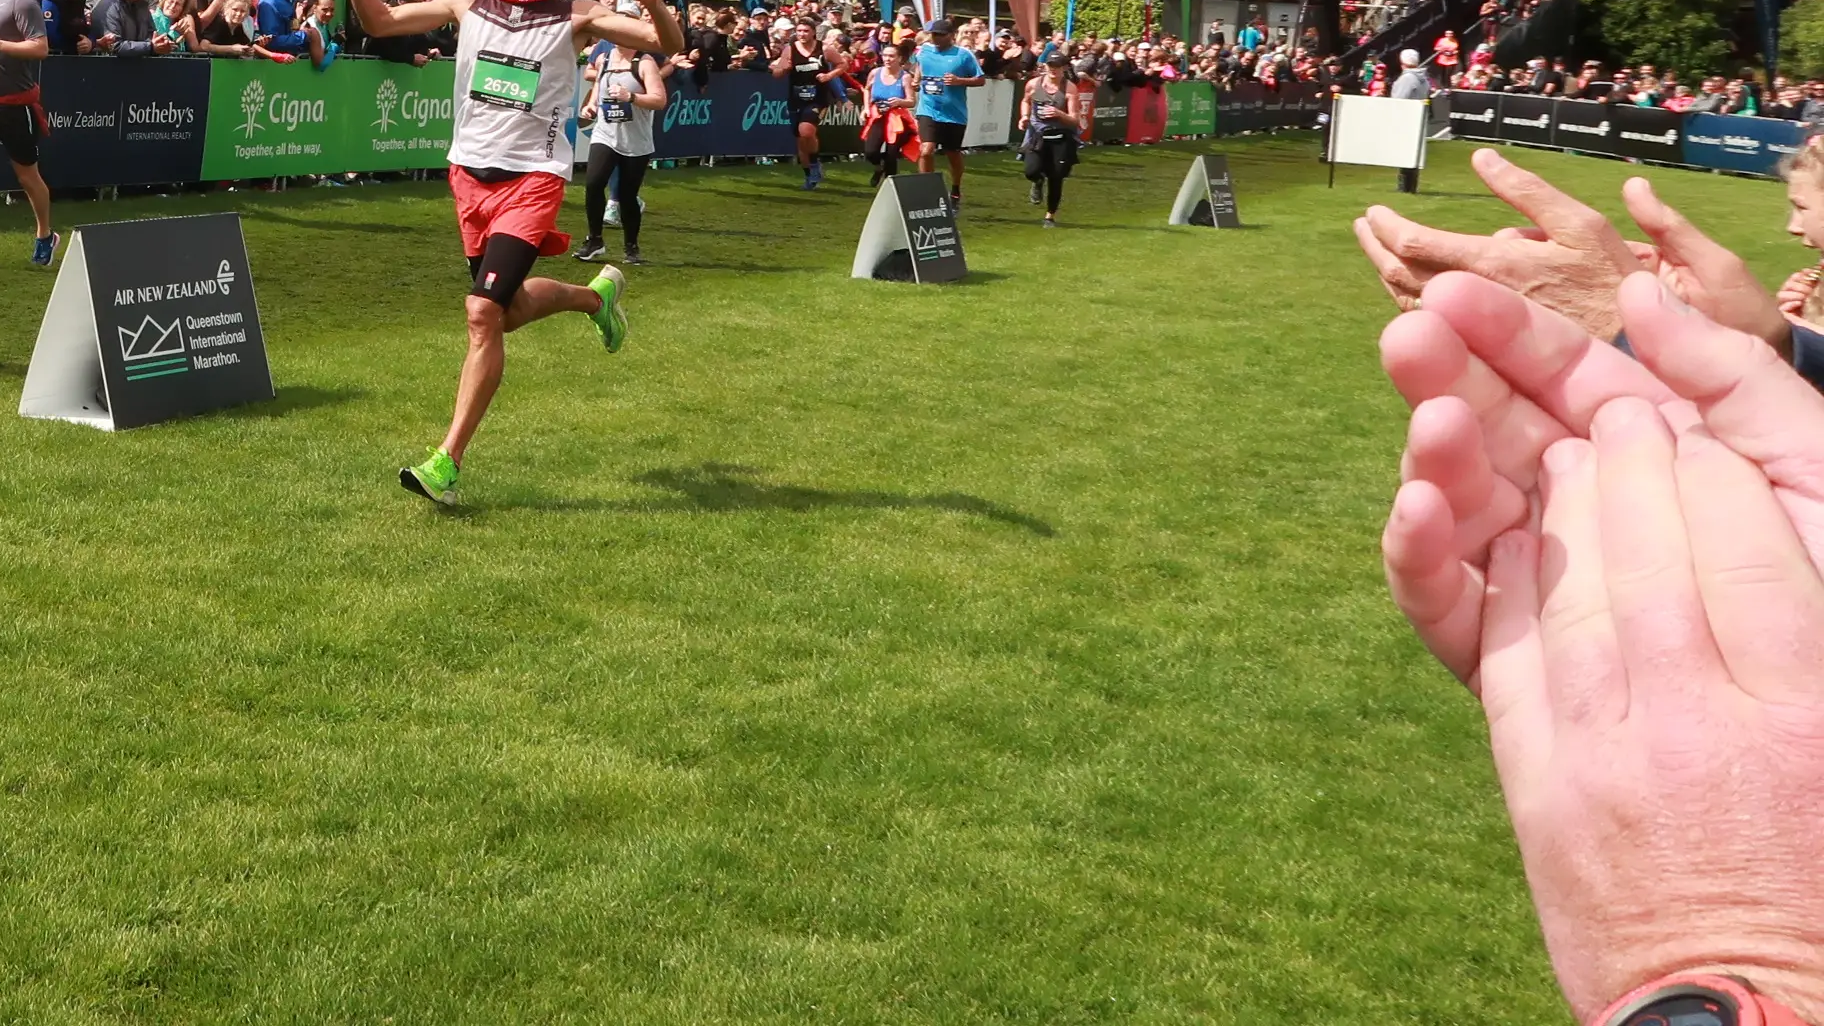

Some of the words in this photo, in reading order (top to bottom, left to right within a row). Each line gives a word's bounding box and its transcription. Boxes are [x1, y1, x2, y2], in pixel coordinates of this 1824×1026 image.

[483, 77, 520, 96] 2679
[47, 111, 72, 128] New
[74, 111, 115, 128] Zealand
[127, 101, 194, 128] Sotheby's
[269, 92, 326, 131] Cigna
[401, 91, 452, 127] Cigna
[678, 99, 713, 125] asics
[759, 100, 792, 125] asic
[818, 105, 865, 126] ARMIN
[126, 131, 171, 140] INTERNATIONAL
[171, 131, 192, 140] REALTY
[372, 139, 406, 153] Together,
[407, 138, 417, 150] all
[418, 138, 432, 149] the
[235, 143, 275, 160] Together,
[275, 142, 286, 155] all
[288, 142, 302, 155] the
[303, 143, 322, 156] way.
[114, 289, 135, 306] AIR
[137, 285, 163, 303] NEW
[166, 279, 217, 300] ZEALAND
[186, 311, 243, 330] Queenstown
[189, 328, 247, 350] International
[193, 351, 241, 370] Marathon.
